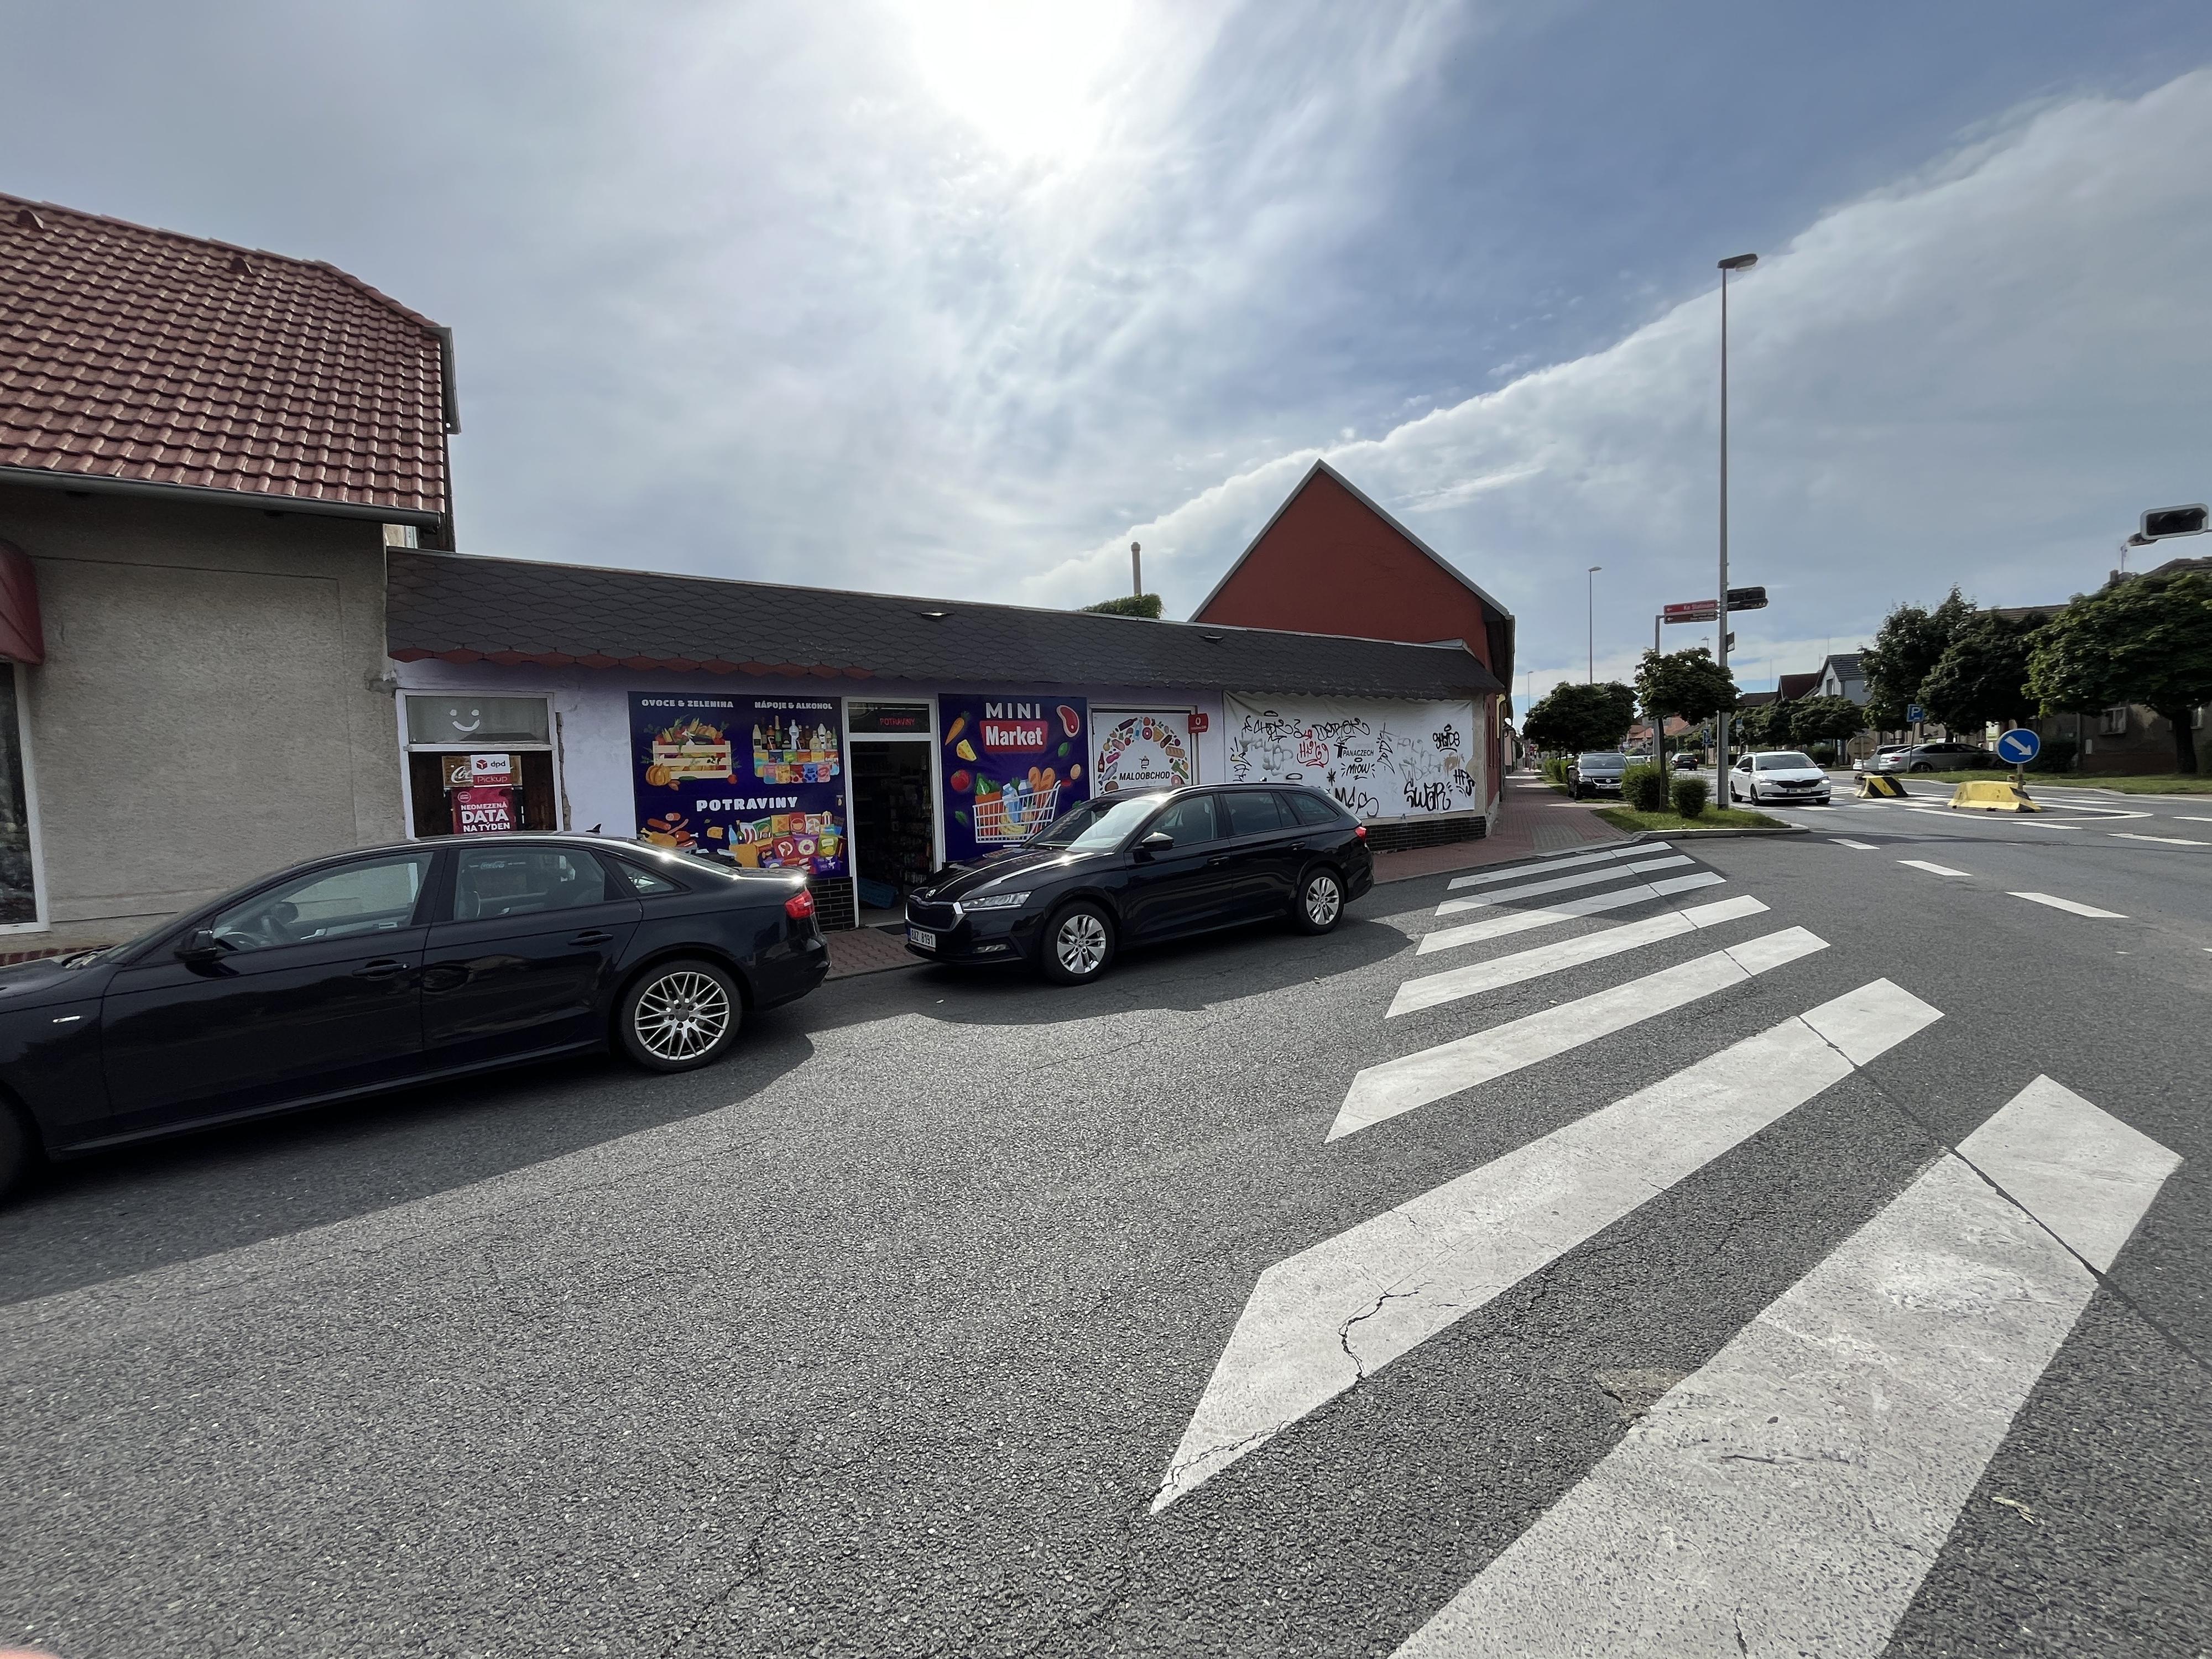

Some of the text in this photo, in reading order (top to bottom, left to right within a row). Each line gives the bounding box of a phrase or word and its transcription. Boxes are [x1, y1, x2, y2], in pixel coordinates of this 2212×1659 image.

[641, 699, 676, 707] OVOCE
[754, 700, 787, 709] NÁPOJE
[985, 702, 1041, 719] MINI
[1911, 707, 1921, 717] P
[985, 726, 1044, 746] Market
[1119, 771, 1170, 780] MALOOBCHOD
[461, 801, 508, 810] NEOMEZENÁ
[696, 797, 798, 812] POTRAVINY
[461, 808, 509, 824] DATA
[478, 822, 510, 831] TÝDEN
